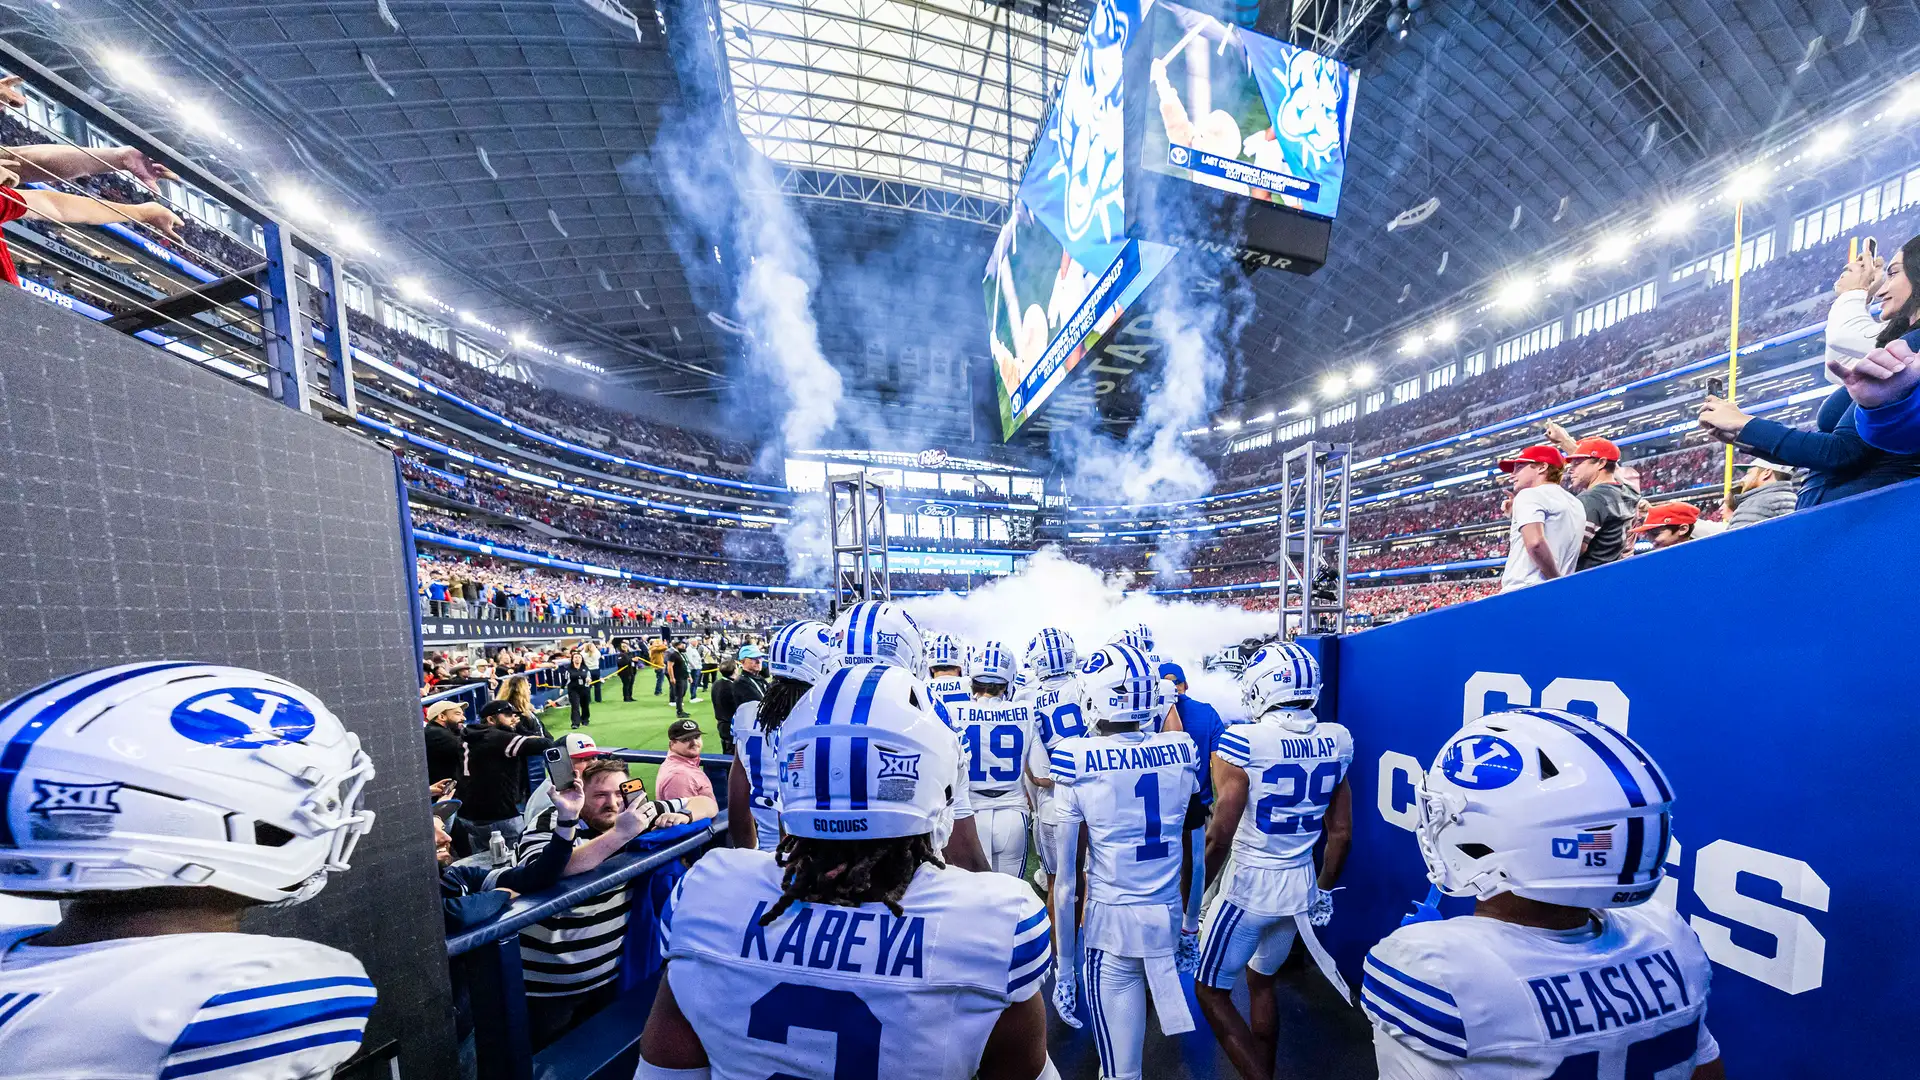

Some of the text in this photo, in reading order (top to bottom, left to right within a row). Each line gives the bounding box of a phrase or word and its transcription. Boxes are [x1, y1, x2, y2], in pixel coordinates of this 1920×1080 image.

[59, 246, 96, 268] EMMITT
[97, 263, 126, 284] SMITH
[1068, 257, 1124, 331] CHAMPIONSHIP
[1054, 332, 1082, 368] MOUNTAIN
[1080, 308, 1097, 334] WEST
[924, 505, 950, 516] Ford
[844, 656, 853, 665] GO
[957, 706, 1029, 722] T. BACHMEIER
[965, 724, 1024, 782] 19
[1085, 746, 1178, 773] ALEXANDER
[1280, 737, 1335, 759] DUNLAP
[792, 771, 800, 788] 2
[880, 755, 918, 778] XII
[34, 784, 118, 810] XII
[1255, 761, 1342, 835] 29
[814, 818, 868, 832] GO COUGS
[1134, 772, 1169, 862] 1
[1585, 852, 1607, 867] 15
[741, 901, 926, 979] KABEYA
[1528, 949, 1691, 1041] BEASLEY
